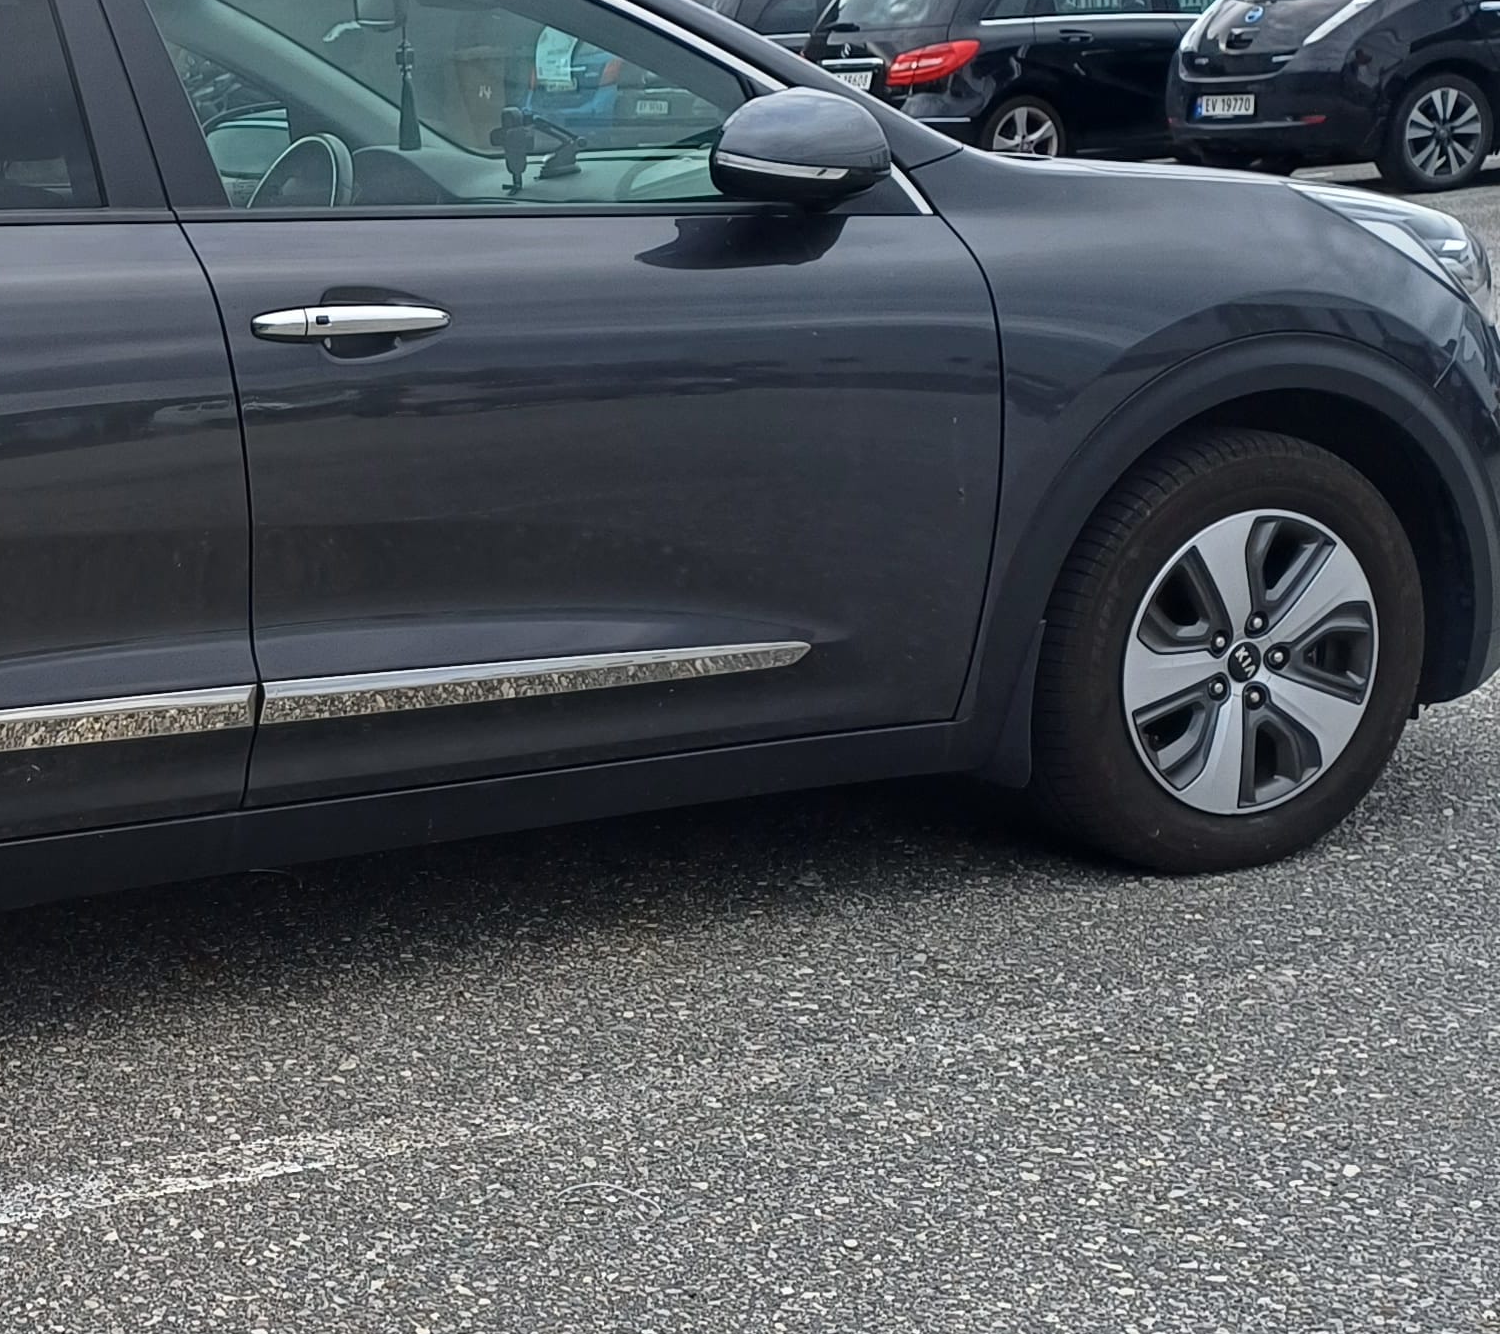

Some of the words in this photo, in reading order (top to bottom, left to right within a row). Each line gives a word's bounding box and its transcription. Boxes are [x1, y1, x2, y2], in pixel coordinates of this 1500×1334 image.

[1205, 98, 1217, 112] EV
[1221, 97, 1251, 112] 19770
[1235, 645, 1256, 678] KIA
